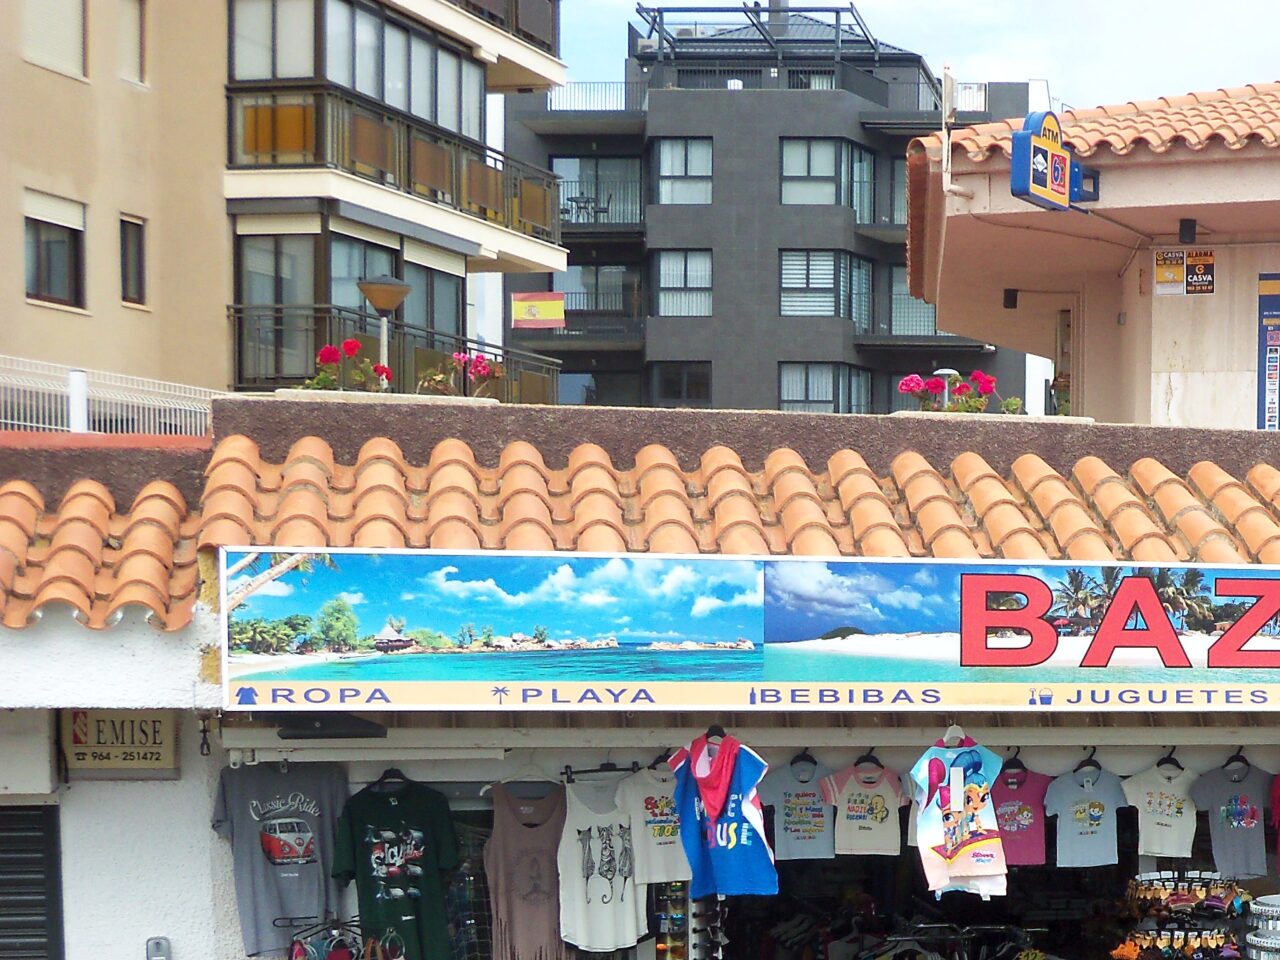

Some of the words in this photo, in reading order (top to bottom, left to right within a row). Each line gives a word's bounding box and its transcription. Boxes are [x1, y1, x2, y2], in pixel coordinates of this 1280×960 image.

[1041, 126, 1059, 144] ATM
[1187, 274, 1213, 282] CASVA
[270, 687, 392, 704] ROPA
[521, 687, 657, 704] PLAYA
[760, 687, 942, 705] BEBIBAS
[1065, 688, 1270, 705] JUGUETES
[91, 751, 111, 761] 964
[122, 751, 162, 761] 251472
